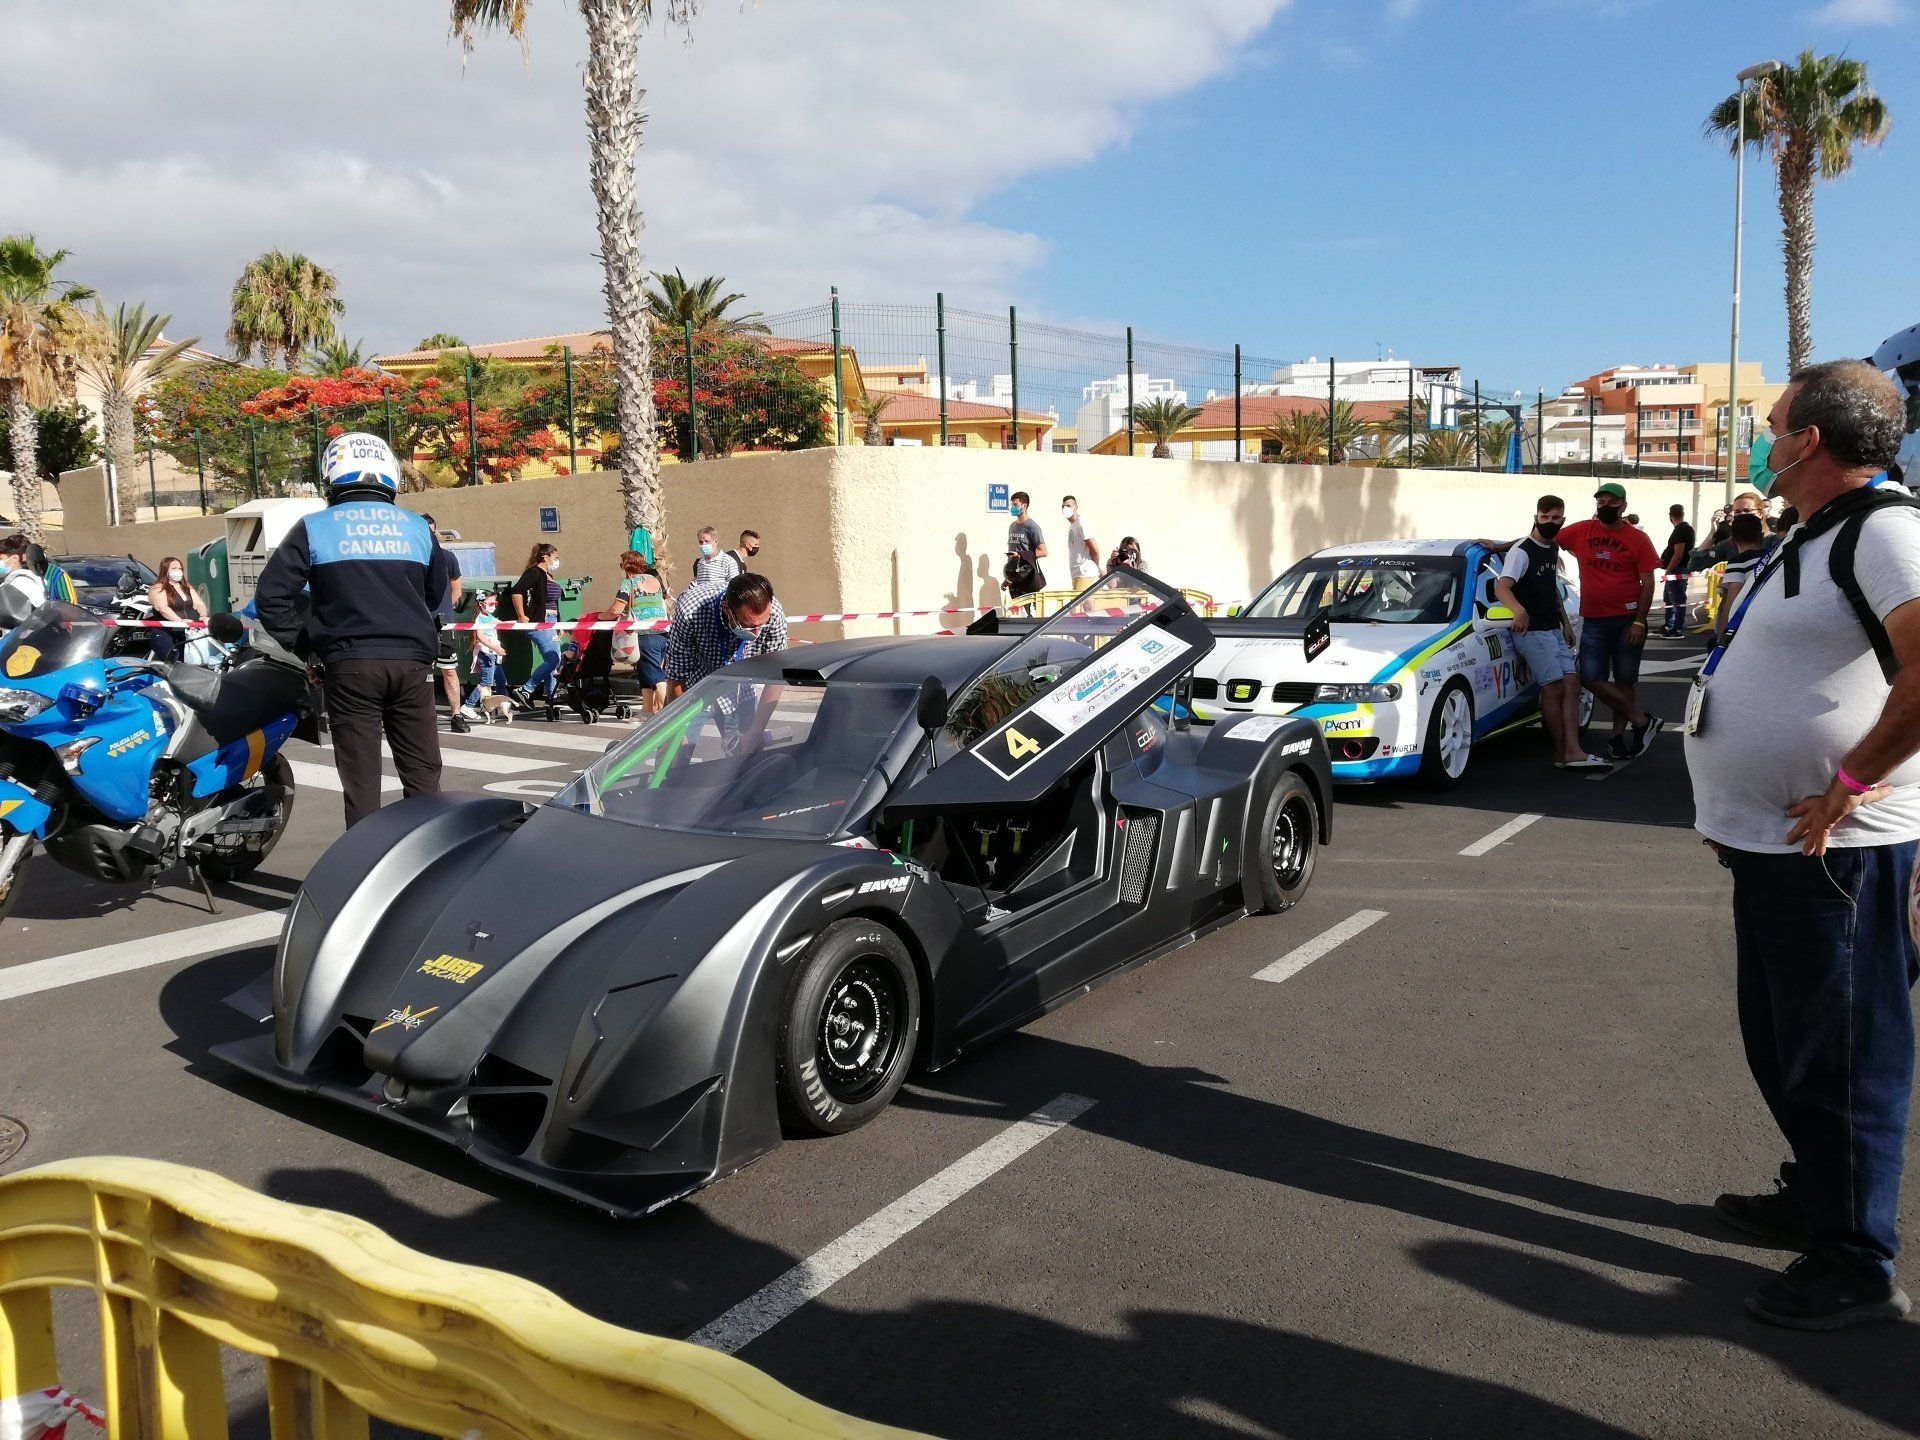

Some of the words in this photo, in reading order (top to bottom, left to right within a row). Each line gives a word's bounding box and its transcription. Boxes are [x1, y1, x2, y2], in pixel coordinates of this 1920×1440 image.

[349, 438, 387, 452] POLICIA
[353, 448, 385, 461] LOCAL
[333, 508, 410, 521] POLICIA
[345, 523, 402, 536] LOCAL
[339, 540, 412, 555] CANARIA
[1586, 536, 1628, 554] TOMMY
[1537, 562, 1557, 576] TOMM
[1005, 727, 1041, 760] 4
[1288, 738, 1313, 754] AVON
[869, 875, 911, 892] AVON
[416, 965, 468, 984] RACING
[800, 1057, 843, 1123] AVON
